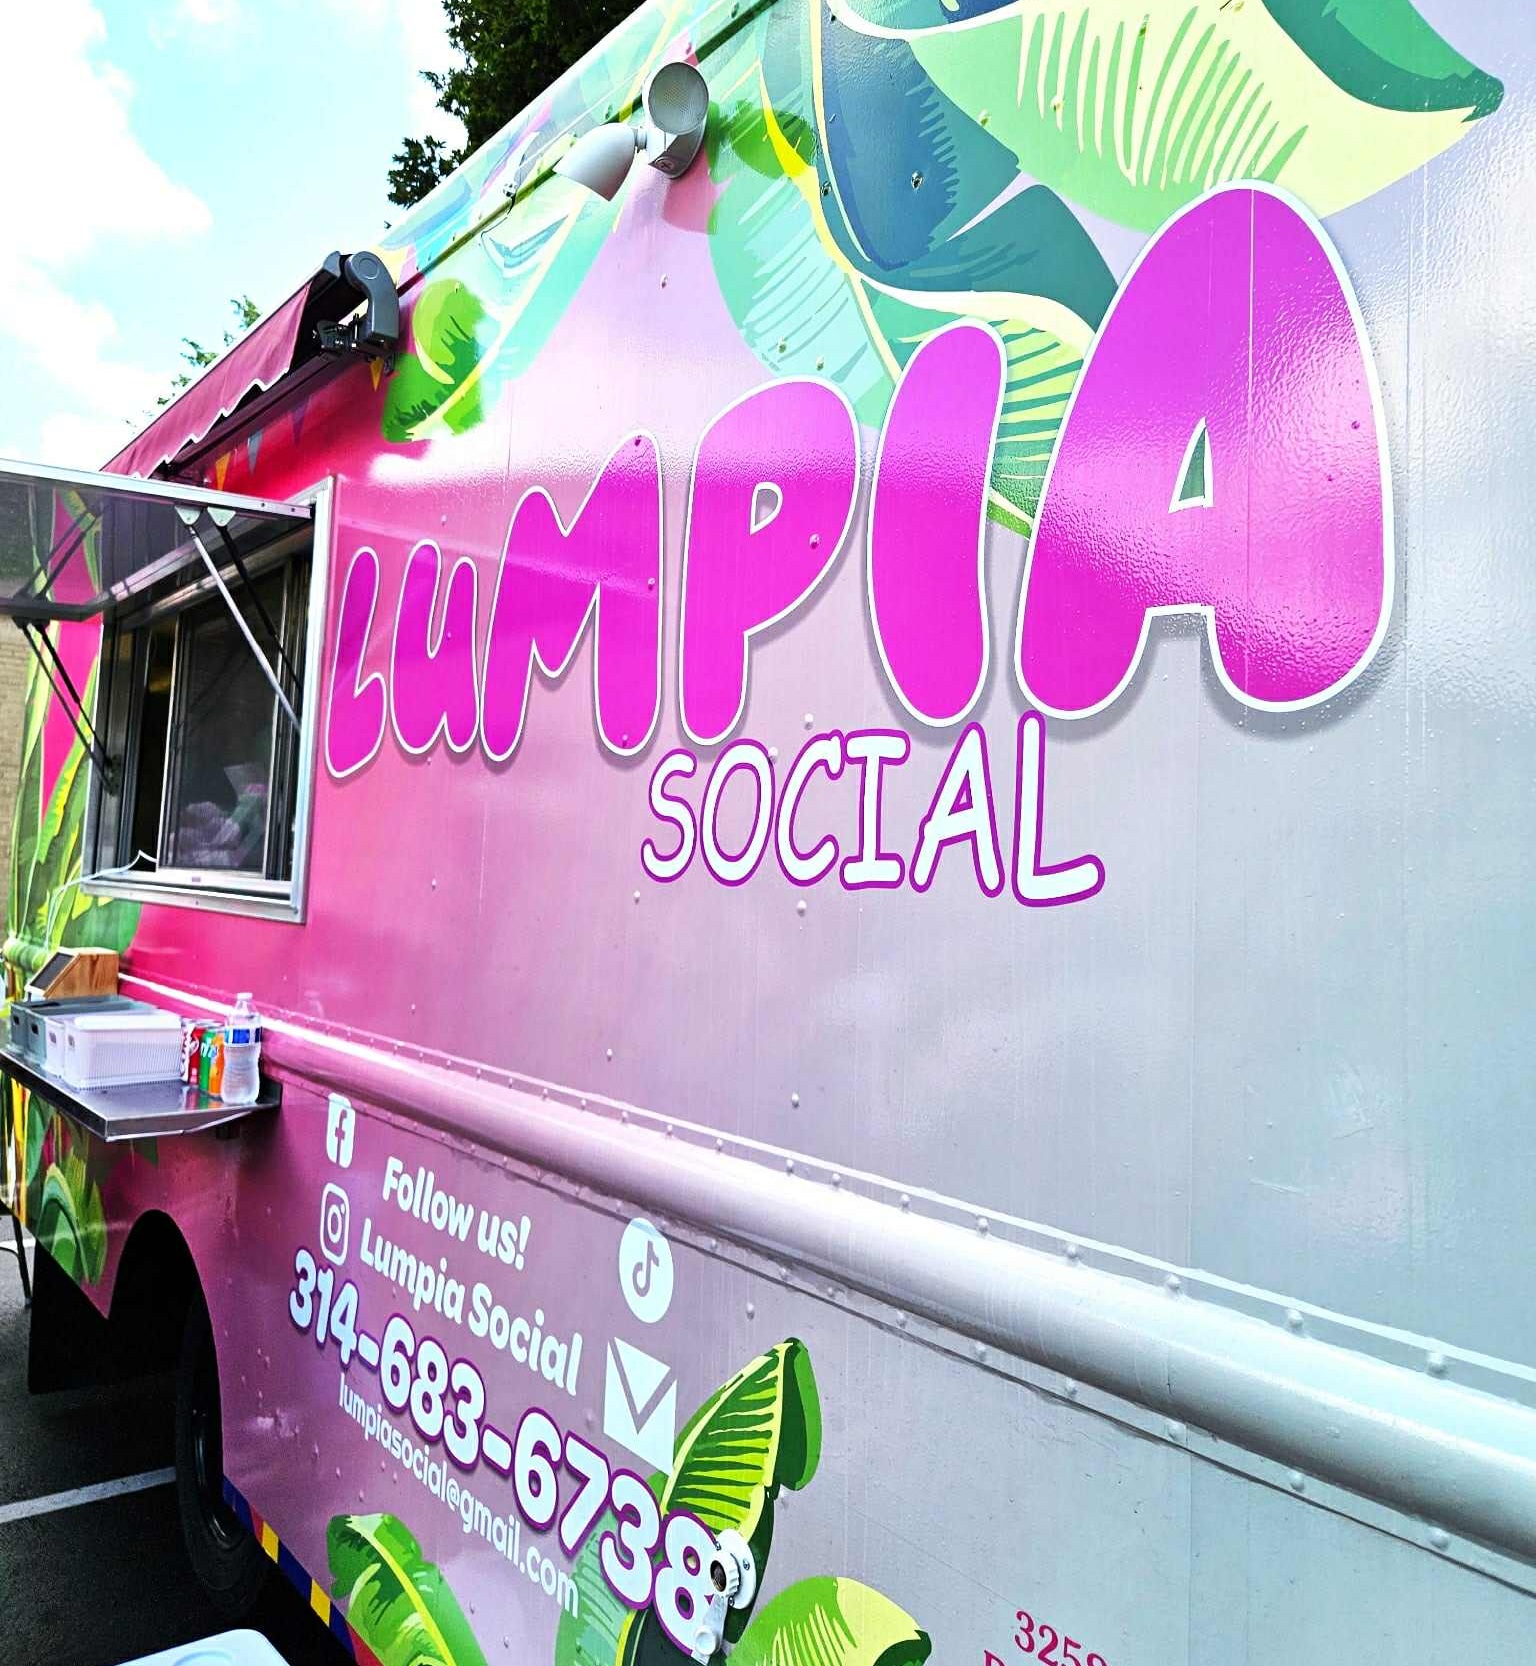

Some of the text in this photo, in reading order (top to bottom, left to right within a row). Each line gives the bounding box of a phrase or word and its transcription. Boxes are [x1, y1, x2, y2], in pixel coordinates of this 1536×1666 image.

[324, 179, 1396, 780] LUMPIA
[641, 709, 1106, 907] SOCIAL
[360, 1218, 584, 1397] Lumpia Social
[382, 1156, 532, 1270] Follow us!
[287, 1248, 724, 1662] 314-683-6738
[337, 1372, 581, 1618] lumpiasocial@gmail.com
